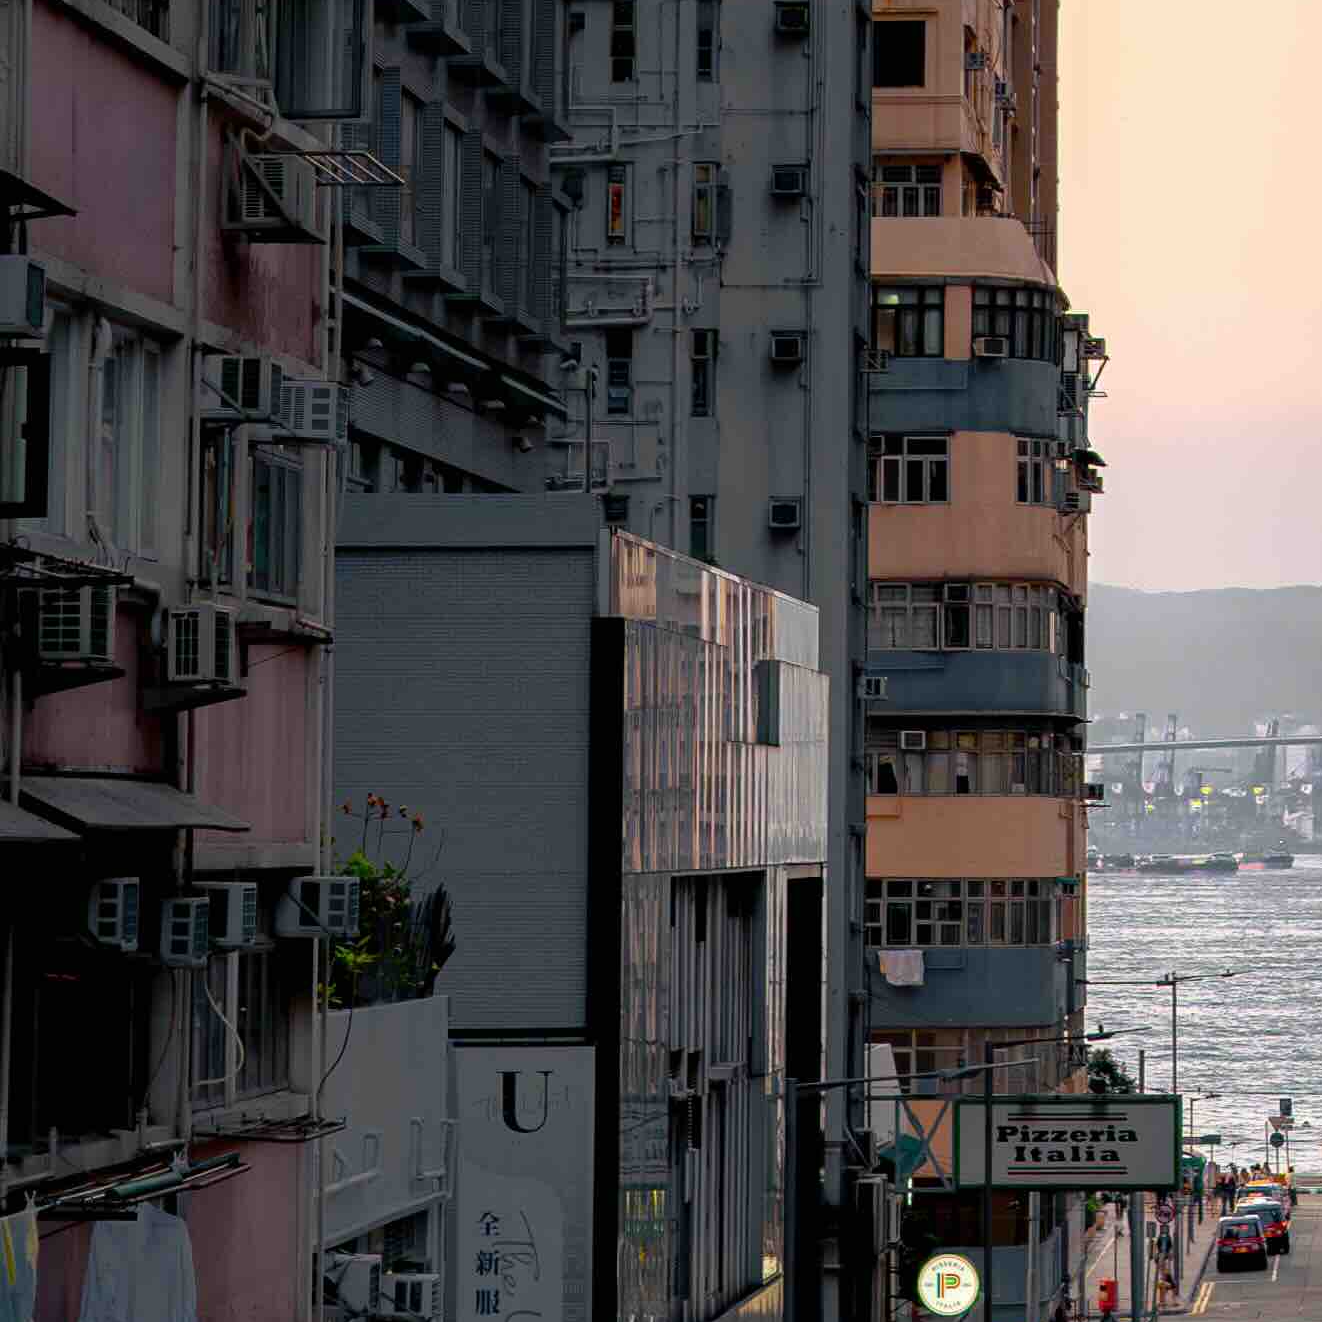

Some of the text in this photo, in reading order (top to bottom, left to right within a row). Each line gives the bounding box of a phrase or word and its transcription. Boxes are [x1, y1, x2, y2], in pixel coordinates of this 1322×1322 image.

[496, 1070, 553, 1134] U
[997, 1124, 1138, 1143] Pizzeria
[1013, 1145, 1121, 1162] Italia
